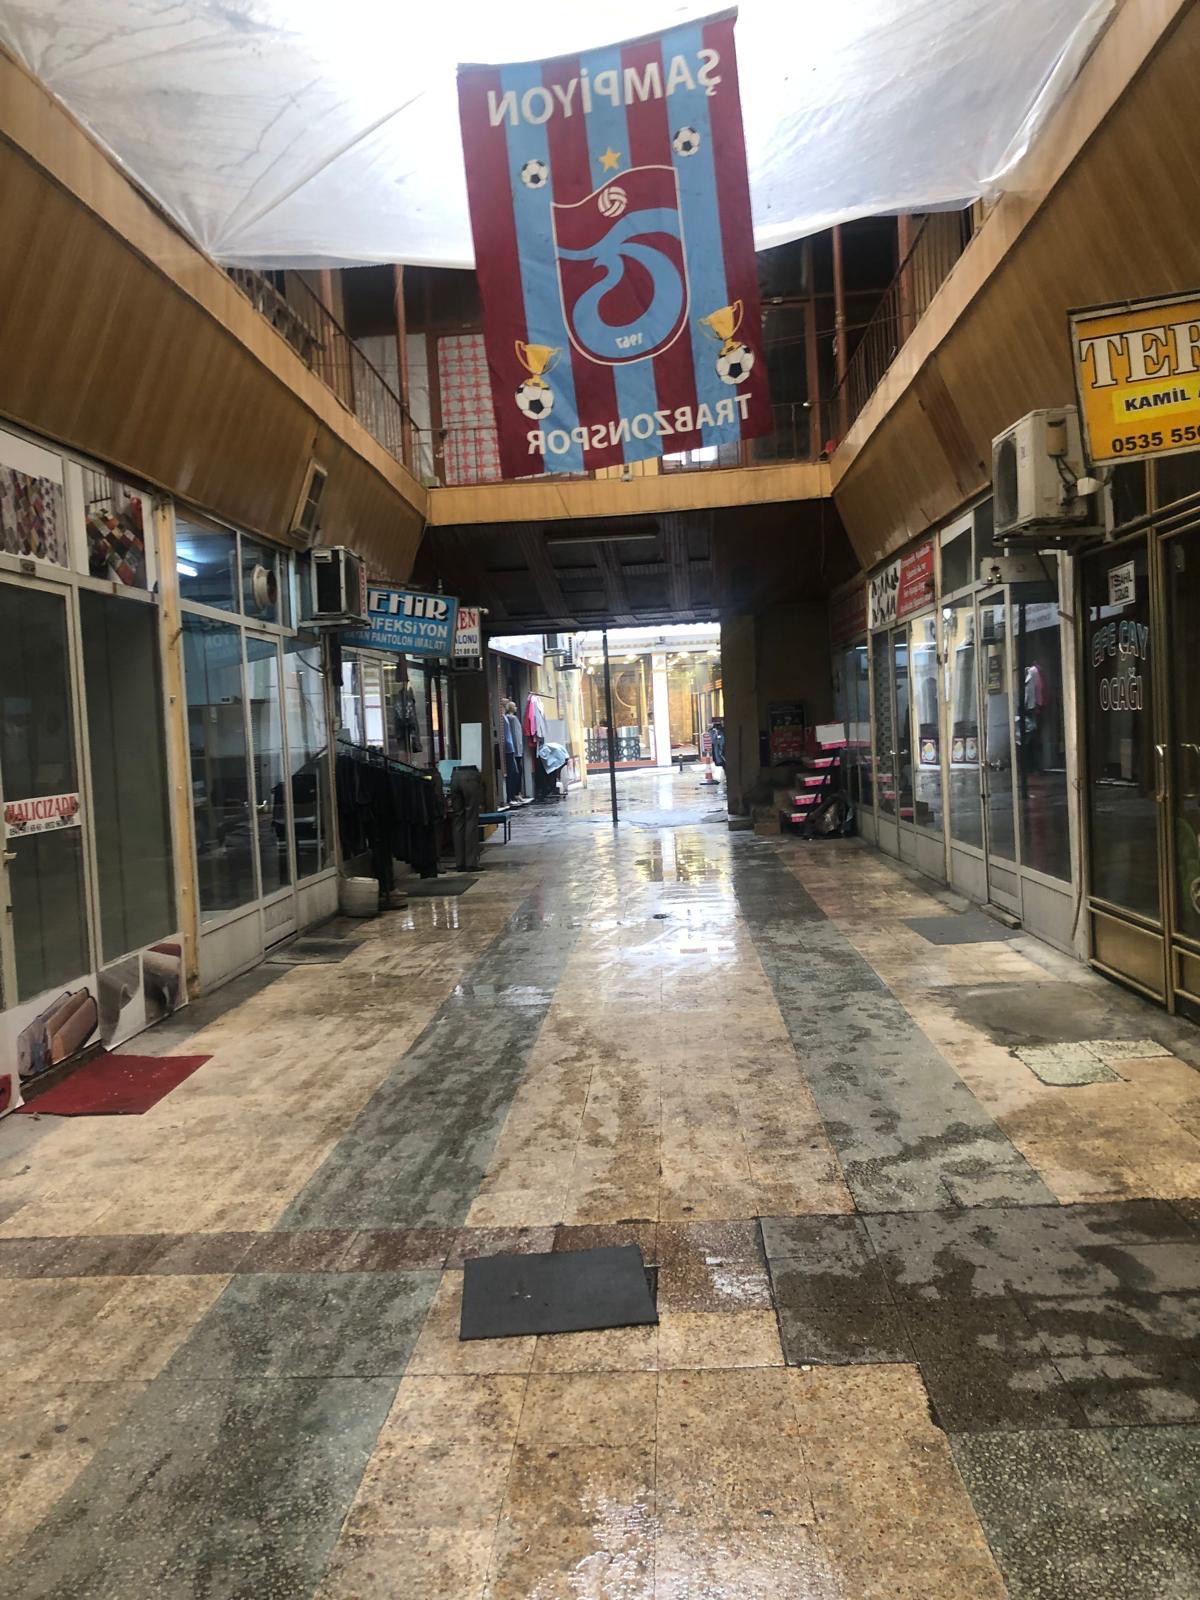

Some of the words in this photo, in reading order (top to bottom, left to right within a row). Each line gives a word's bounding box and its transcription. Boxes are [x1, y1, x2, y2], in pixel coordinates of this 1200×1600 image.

[1124, 387, 1191, 411] KAMİL
[1112, 431, 1163, 453] 0535
[371, 631, 413, 647] PANTOLON
[1092, 622, 1116, 668] EFE
[1119, 620, 1149, 662] ÇAY
[1101, 667, 1143, 711] OCAĞI
